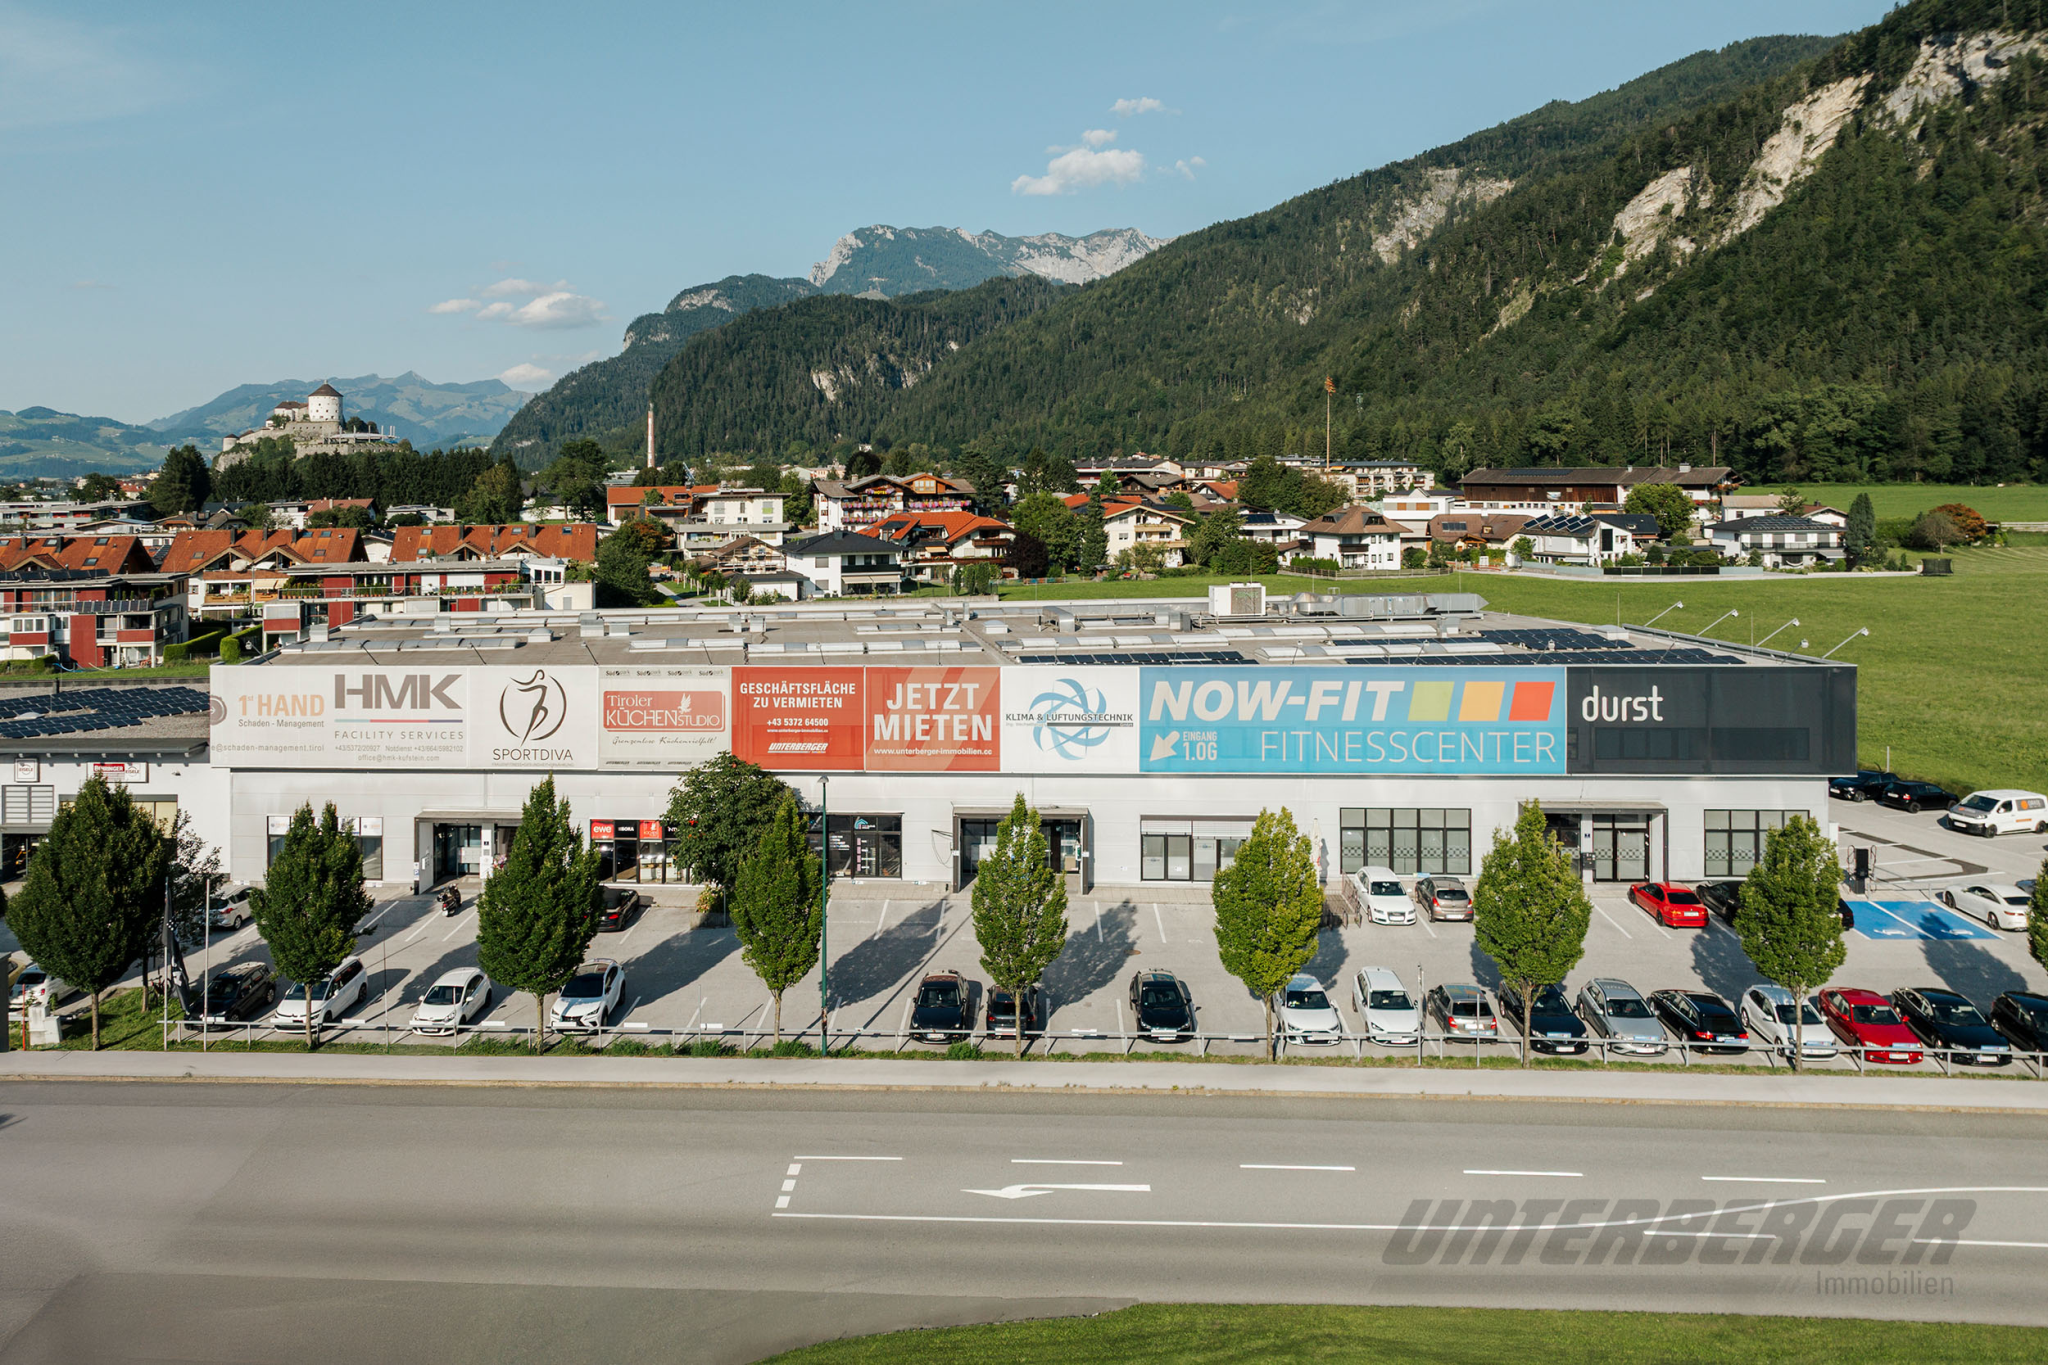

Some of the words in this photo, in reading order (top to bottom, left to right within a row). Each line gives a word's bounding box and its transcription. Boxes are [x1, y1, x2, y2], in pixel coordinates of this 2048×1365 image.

[335, 674, 462, 709] HMK
[740, 680, 856, 694] GESCHÄFTSFLÄCHE
[607, 694, 653, 707] Tiroler
[753, 697, 769, 708] ZU
[772, 697, 843, 708] VERMIETEN
[886, 683, 979, 710] JETZT
[1148, 680, 1405, 721] NOW-FIT
[258, 694, 324, 717] HAND
[1582, 685, 1663, 722] durst
[767, 718, 782, 726] +43
[784, 718, 803, 726] 5372
[805, 718, 829, 726] 64500
[1005, 713, 1035, 721] KLIMA
[1037, 713, 1043, 721] &
[1046, 711, 1134, 721] LÜFTUNGSTECHNIK
[238, 719, 270, 728] Schaden
[277, 719, 325, 729] Management
[874, 714, 992, 741] MIETEN
[334, 731, 394, 739] FACILITY
[400, 731, 464, 740] SERVICES
[1183, 731, 1218, 741] EINGANG
[768, 743, 829, 751] UNTERBERGER
[873, 748, 992, 756] www.unterberger-immobilien.cc
[1261, 731, 1556, 762] FITNESSCENTER
[493, 748, 573, 760] SPORTDIVA
